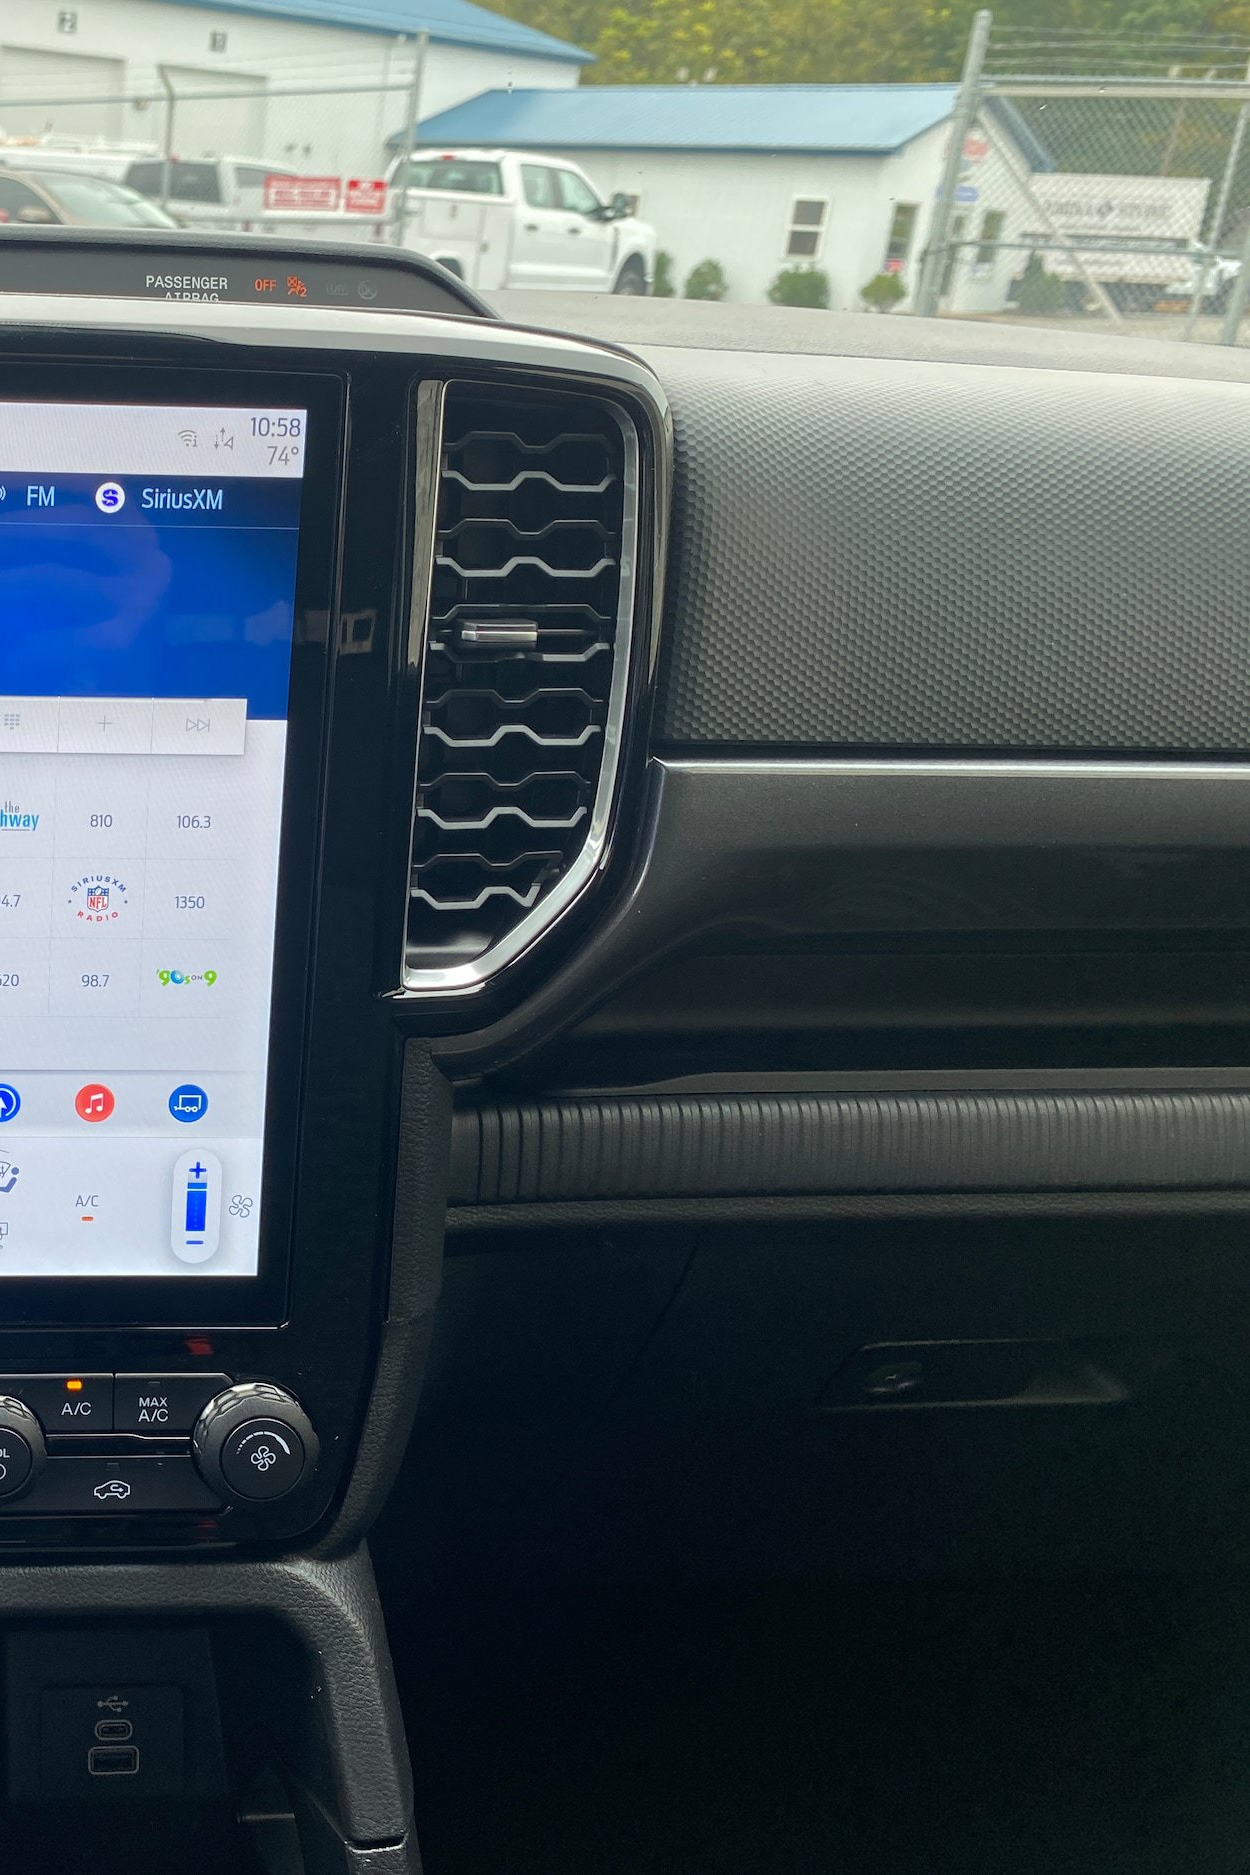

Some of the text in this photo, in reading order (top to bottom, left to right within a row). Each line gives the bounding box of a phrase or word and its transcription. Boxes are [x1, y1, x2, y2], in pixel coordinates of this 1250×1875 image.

[146, 275, 228, 291] PASSENGER
[254, 278, 277, 292] OFF
[250, 416, 302, 438] 10:58
[266, 445, 300, 466] 74°
[26, 486, 55, 507] FM
[141, 487, 224, 510] SiriusXM
[4, 801, 20, 814] the
[89, 814, 113, 828] 810
[177, 815, 212, 829] 106.3
[71, 875, 127, 893] SIRIUSXM
[89, 896, 107, 909] NFL
[174, 896, 206, 909] 1350
[77, 911, 119, 922] RADIO
[81, 974, 110, 988] 98.7
[75, 1194, 100, 1208] A/C
[61, 1401, 92, 1417] A/C
[138, 1397, 168, 1408] MAX
[138, 1408, 169, 1423] A/C
